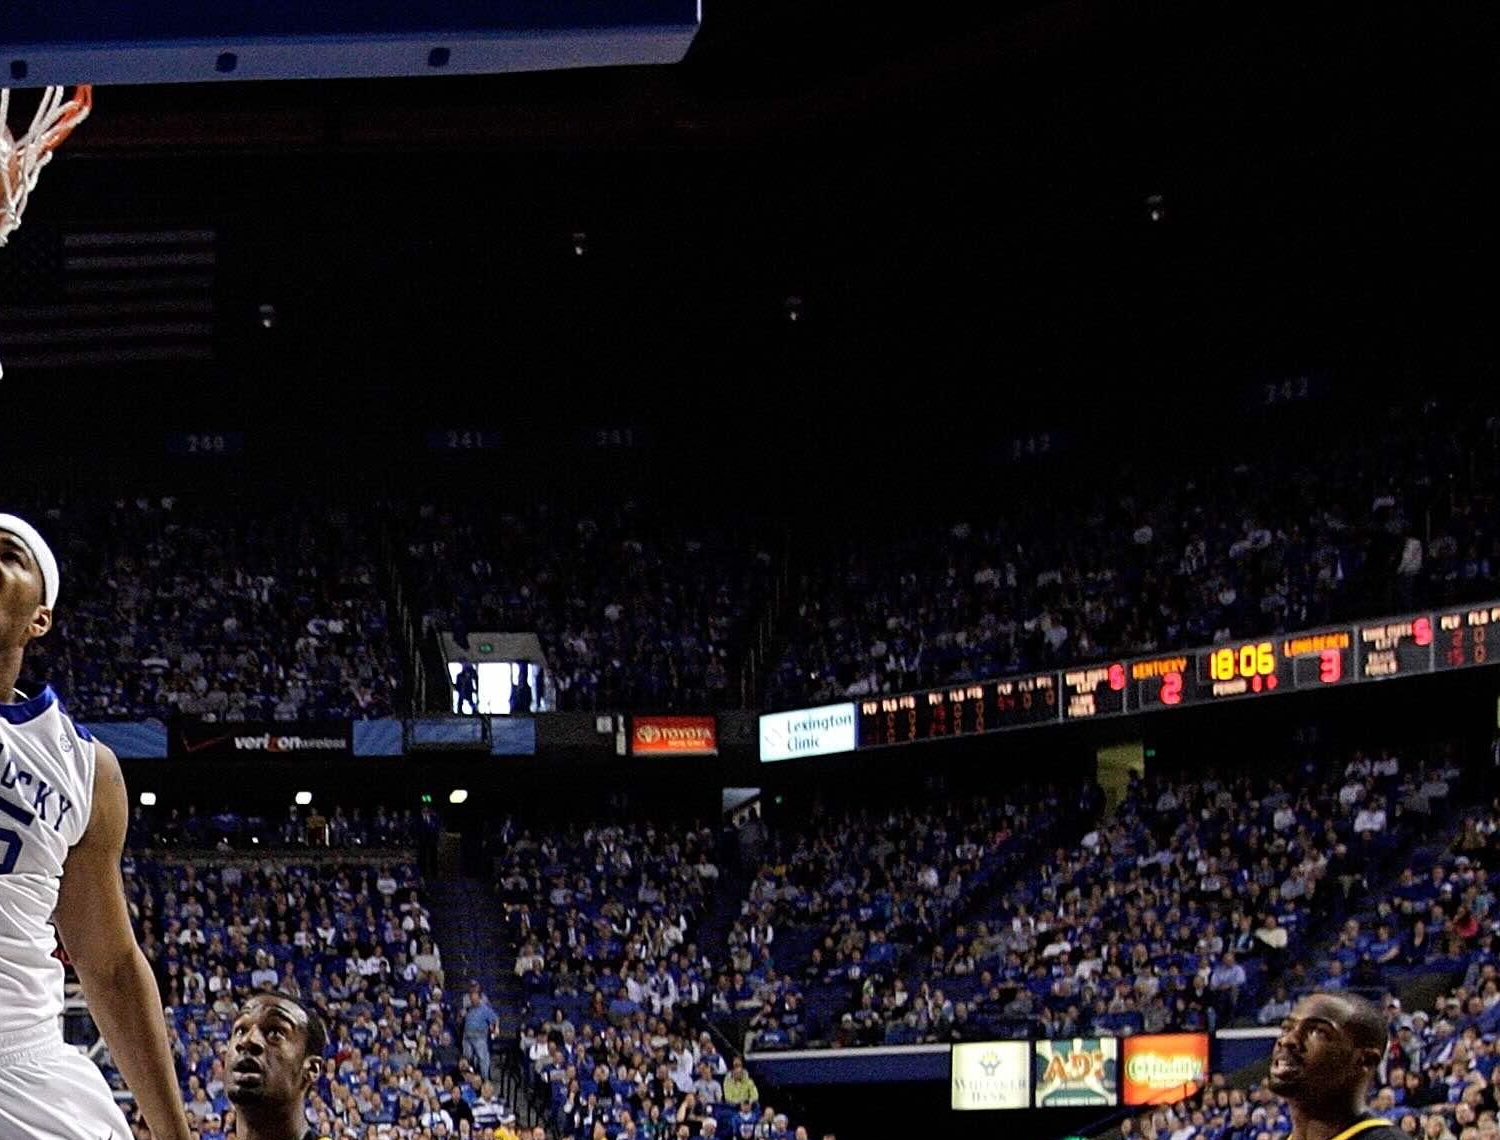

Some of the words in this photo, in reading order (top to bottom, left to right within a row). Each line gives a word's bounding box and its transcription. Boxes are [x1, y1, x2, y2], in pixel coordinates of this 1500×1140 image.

[1319, 649, 1341, 683] 3
[1160, 673, 1182, 705] 2
[787, 714, 853, 733] Lexington
[660, 727, 712, 740] TOYOTA
[787, 736, 821, 752] Clinic
